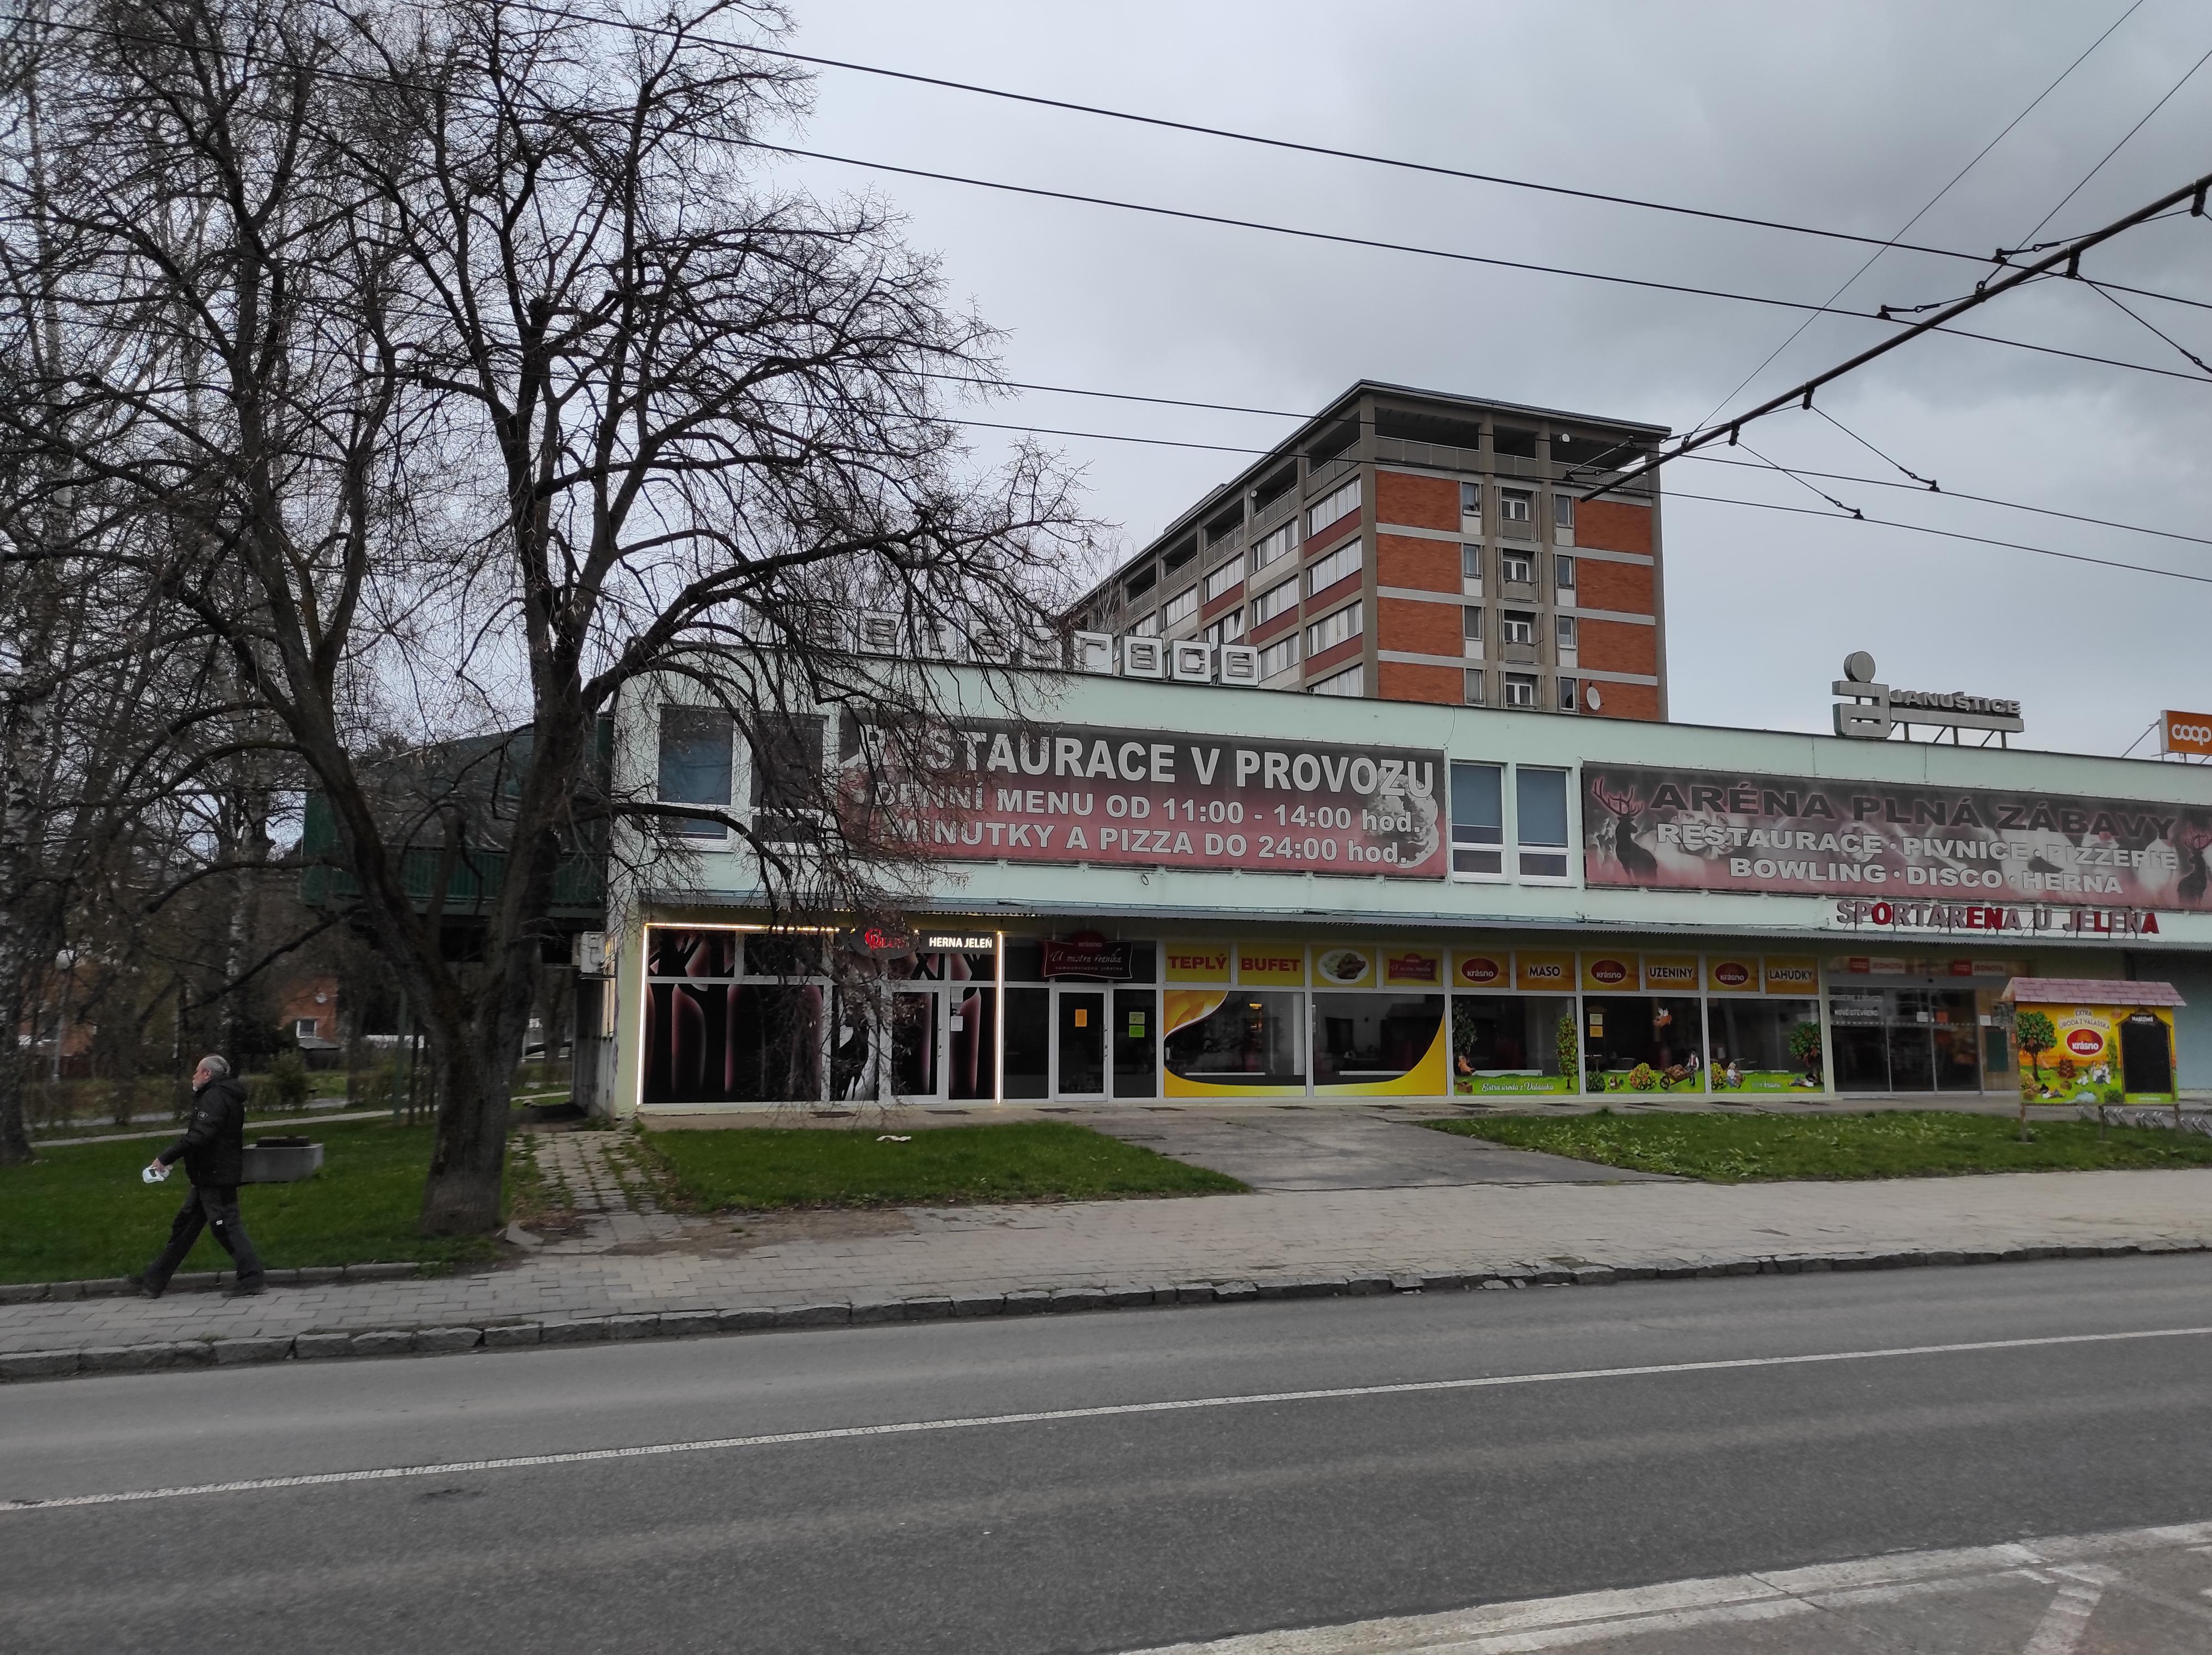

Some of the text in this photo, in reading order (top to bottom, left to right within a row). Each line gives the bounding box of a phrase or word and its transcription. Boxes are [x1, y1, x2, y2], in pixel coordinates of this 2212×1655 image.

[2172, 724, 2211, 746] coop
[858, 724, 1433, 798] RESTAURACE V PROVOZU
[875, 781, 983, 811] DENNÍ
[997, 789, 1094, 816] MENU
[1106, 795, 1150, 819] OD
[1163, 798, 1244, 824] 11:00
[1274, 804, 1351, 829] 14:00
[1362, 809, 1421, 833] hod.
[1650, 783, 2177, 839] ARÉNA PLNÁ ZÁBAVY
[1065, 827, 1088, 849] A
[1100, 828, 1194, 855] PIZZA
[1205, 833, 1247, 857] DO
[1258, 835, 1337, 861] 24:00
[1348, 840, 1407, 864] hod.
[1657, 823, 2177, 870] RESTAURACE PIVNICE PIZZERIE
[1730, 858, 2123, 894] BOWLING DISCO HERNA
[1837, 901, 2023, 931] SPORTARENA
[2033, 909, 2053, 931] U
[929, 937, 993, 948] HERNA JELEŇ
[1168, 953, 1301, 972] TEPLÝ BUFET
[1529, 966, 1561, 977] MASO
[1650, 968, 1693, 978] UZENINY
